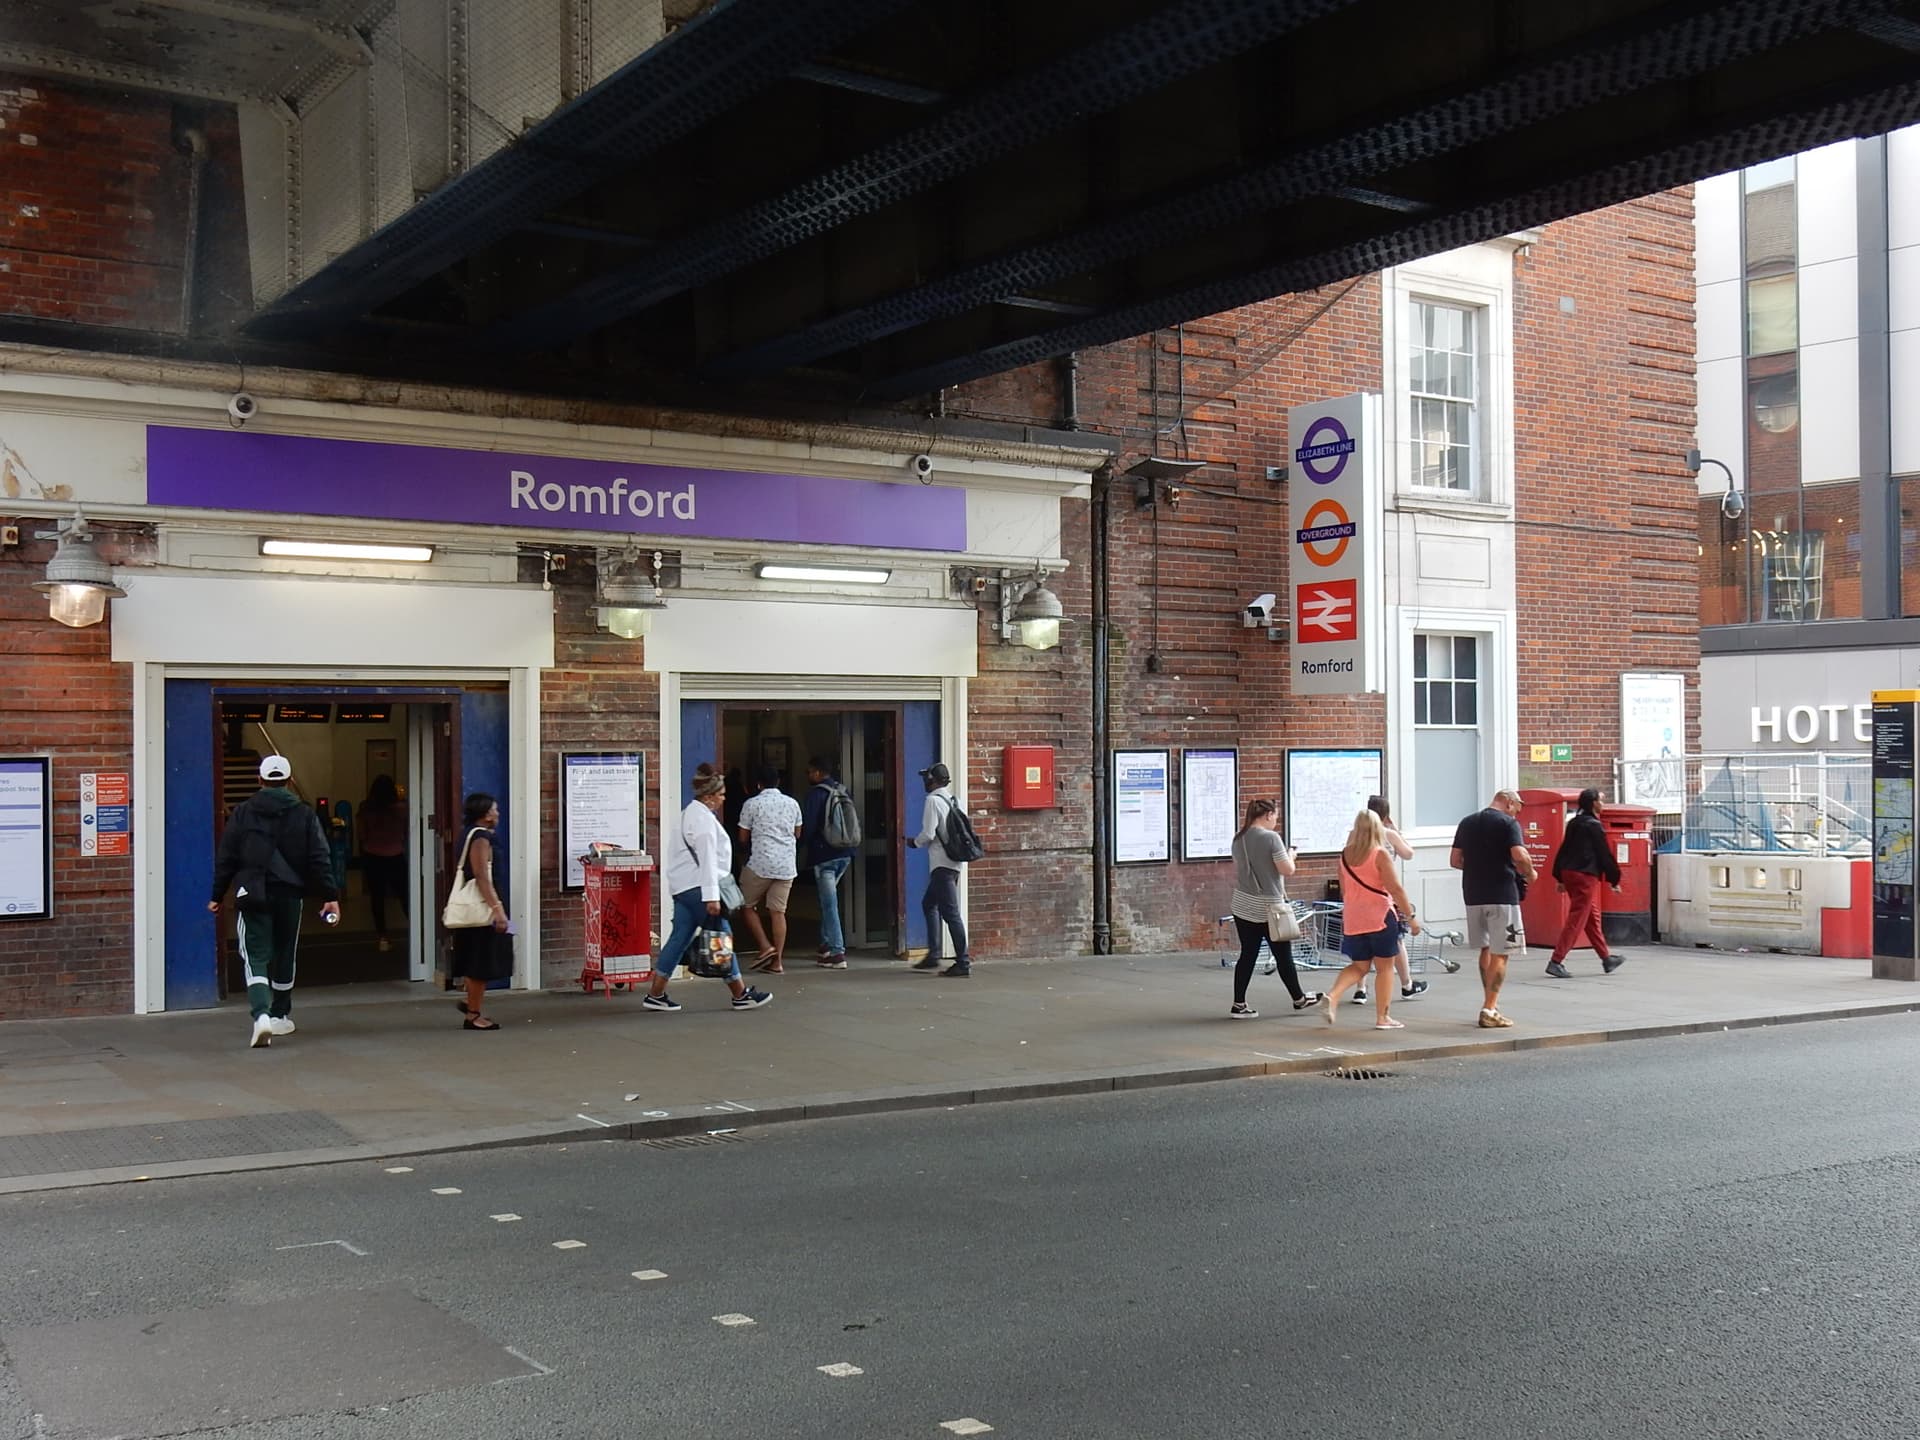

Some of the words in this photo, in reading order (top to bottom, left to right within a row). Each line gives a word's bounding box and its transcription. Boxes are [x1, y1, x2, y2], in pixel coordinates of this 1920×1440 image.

[1298, 446, 1335, 459] ELIZABETH
[1336, 441, 1353, 453] LINE
[511, 471, 696, 520] Romford
[1301, 526, 1352, 540] OVERGROUND
[1301, 658, 1353, 674] Romford
[1751, 704, 1872, 744] HOTE
